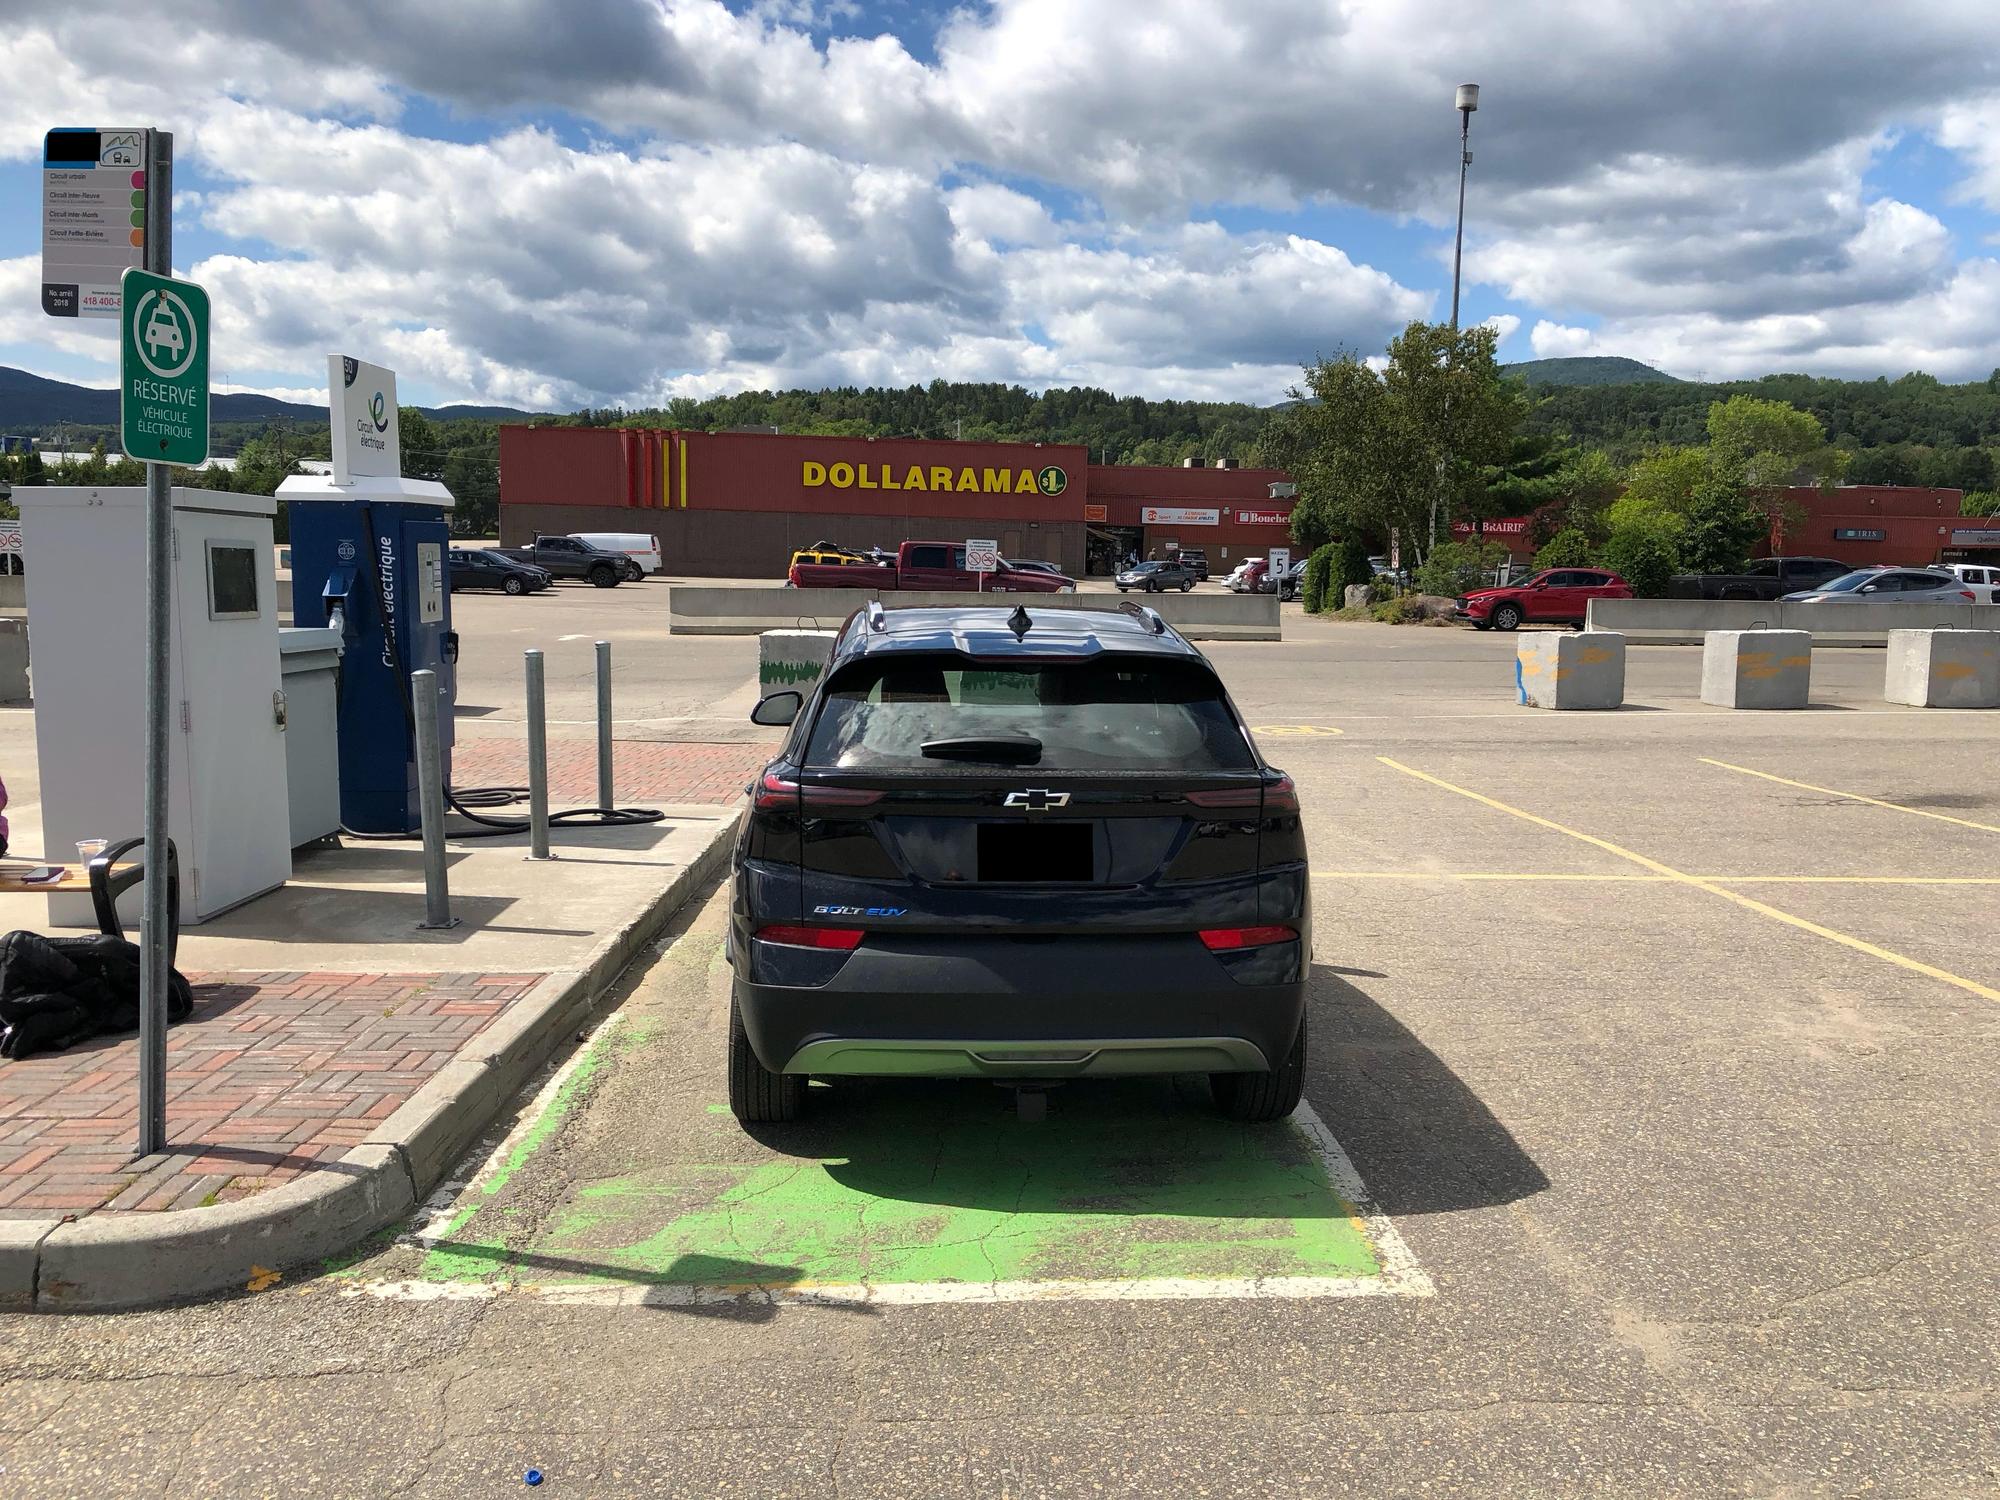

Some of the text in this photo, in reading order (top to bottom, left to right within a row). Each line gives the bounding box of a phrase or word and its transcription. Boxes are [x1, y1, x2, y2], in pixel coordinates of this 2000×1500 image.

[53, 299, 69, 307] 2018
[83, 297, 97, 305] 418
[344, 358, 352, 374] 50
[133, 377, 197, 407] RÉSERVÉ
[142, 405, 188, 424] VÉHICULE
[138, 420, 193, 439] ÉLECTRIQUE
[356, 418, 374, 434] Circuit
[360, 434, 385, 452] électrique
[803, 461, 1039, 494] DOLLARAMA
[1471, 521, 1525, 532] LBRAIRIE
[1276, 558, 1284, 575] 5
[813, 905, 908, 917] BOLT EUV
